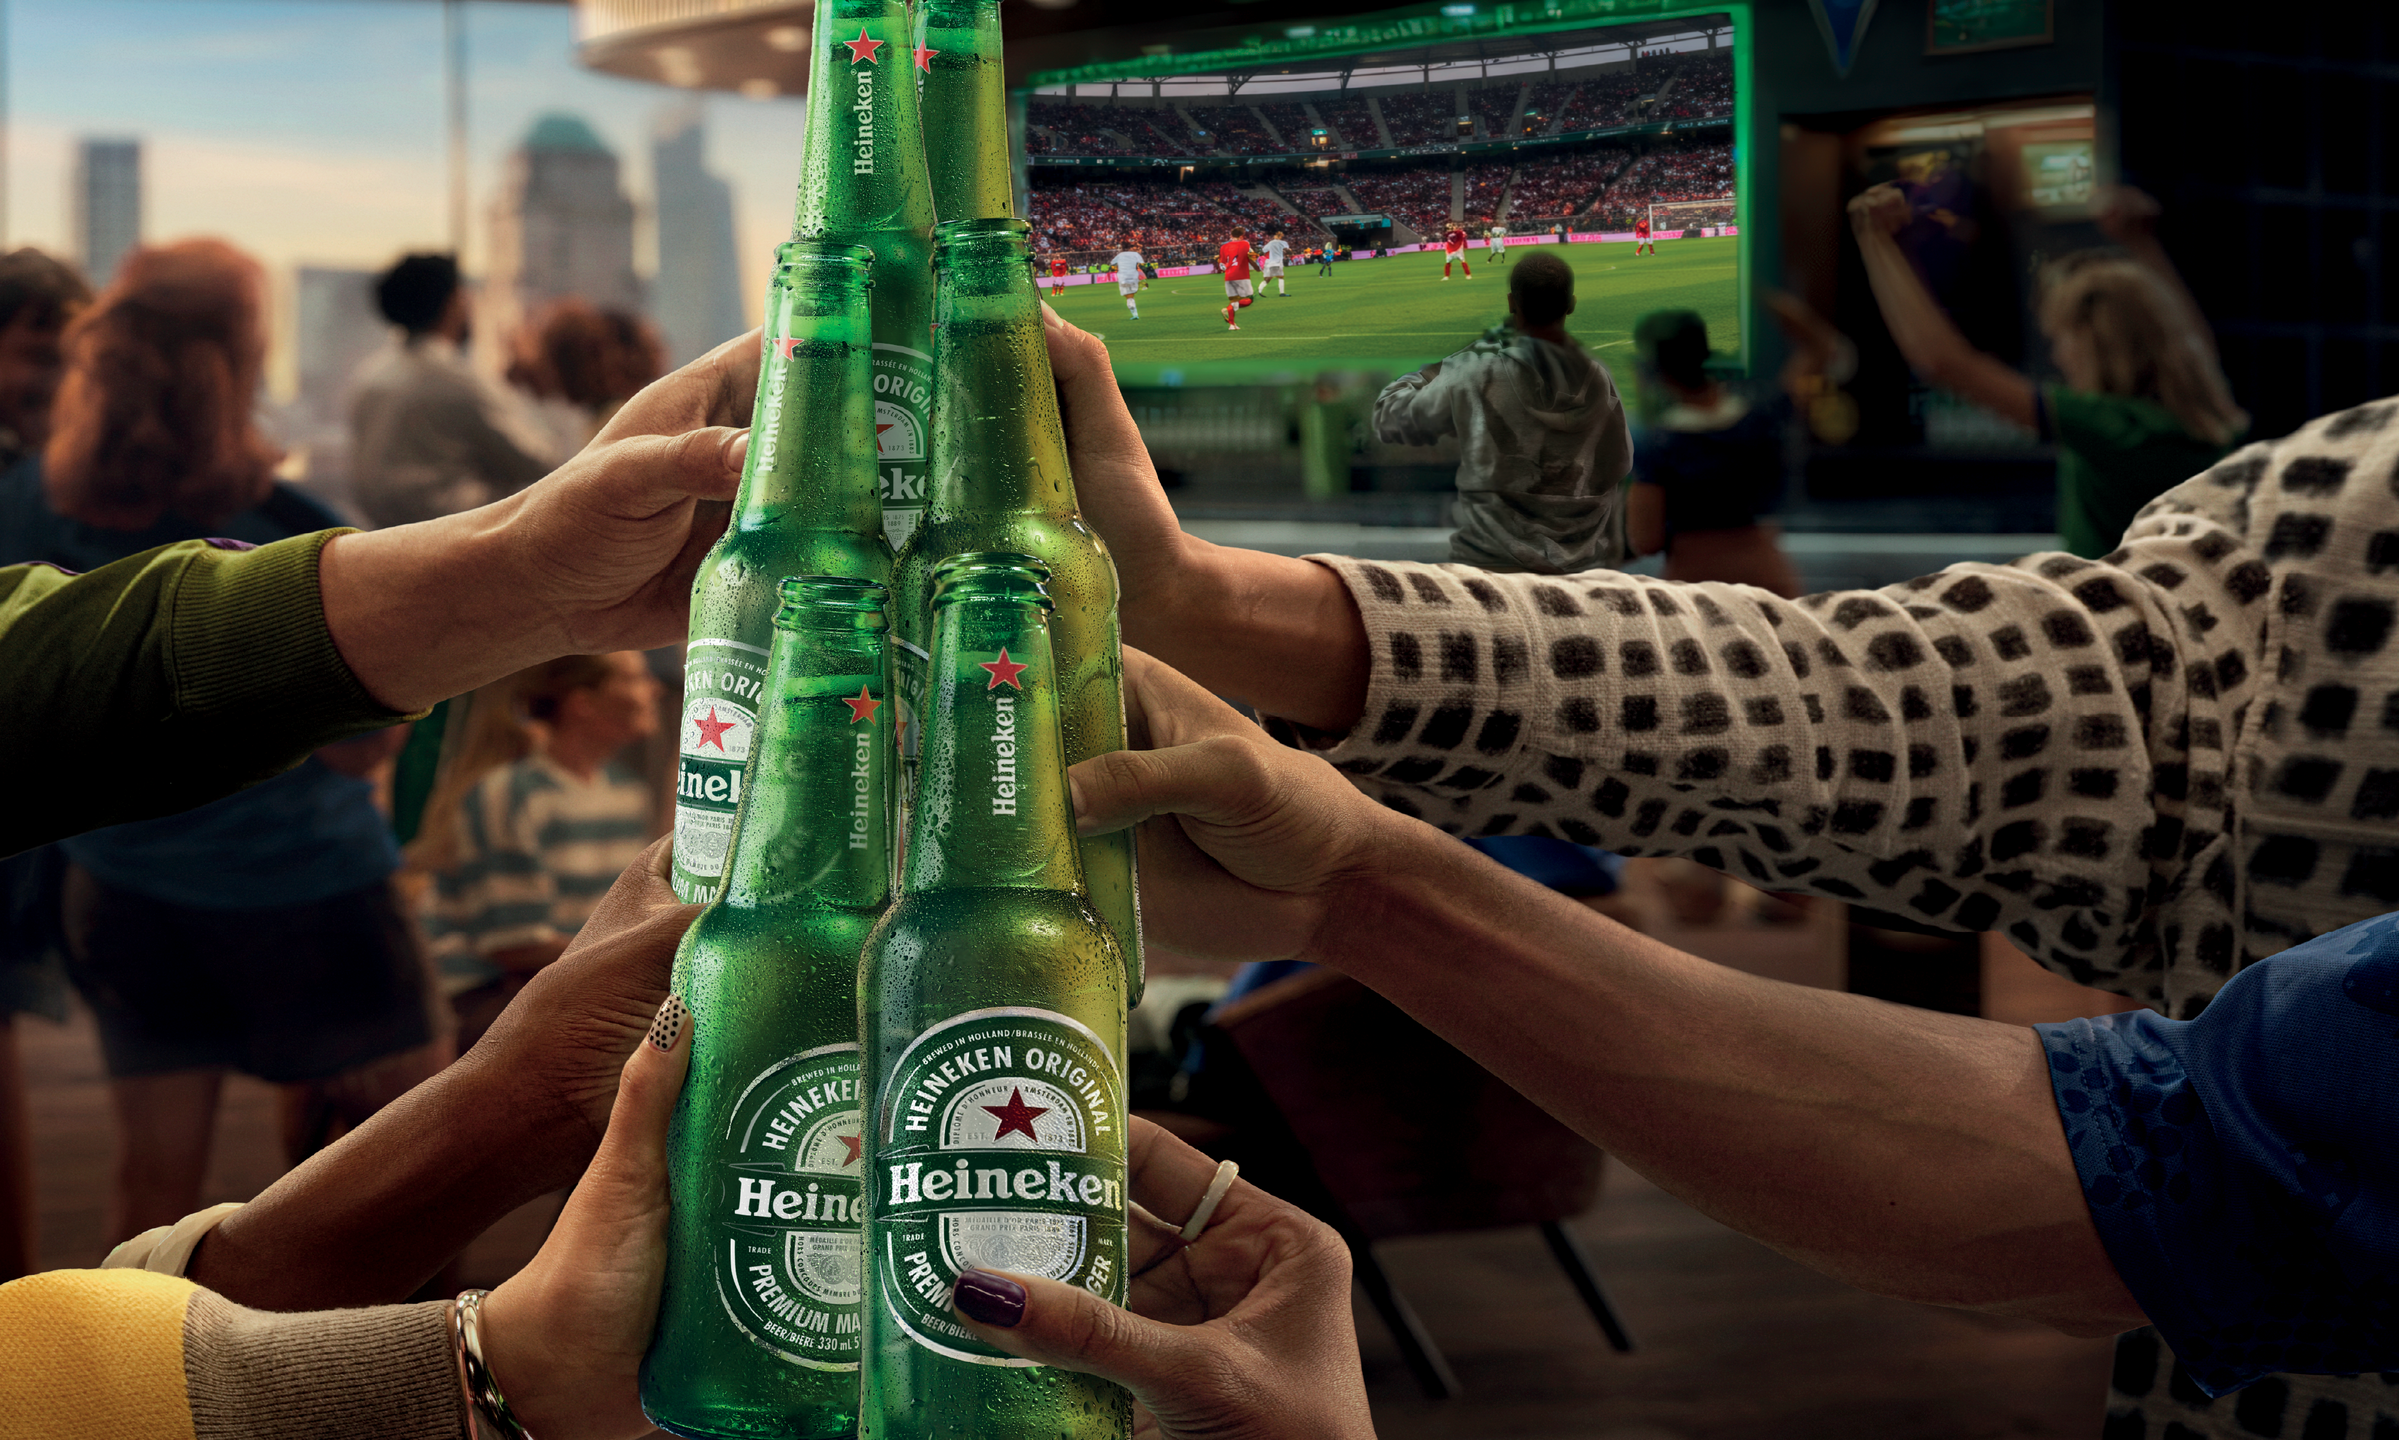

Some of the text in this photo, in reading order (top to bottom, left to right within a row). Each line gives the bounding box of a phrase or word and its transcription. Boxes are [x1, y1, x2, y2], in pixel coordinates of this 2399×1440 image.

[854, 70, 874, 175] Heineken
[898, 363, 908, 371] EN
[908, 366, 932, 384] HOLLAN
[757, 363, 789, 473] Heineken
[876, 407, 910, 428] MSTERDAM
[744, 662, 755, 671] EN
[991, 697, 1017, 817] Heineken
[849, 732, 871, 850] Heineken
[922, 1042, 954, 1065] BREWED
[955, 1037, 966, 1047] IN
[1054, 1037, 1065, 1046] EN
[1066, 1043, 1100, 1071] HOLLANDE
[791, 1069, 824, 1086] BREWED
[826, 1066, 836, 1075] IN
[905, 1046, 1111, 1136] HEINEKEN ORIGINAL
[962, 1085, 1008, 1109] D'HONNEUR
[1024, 1086, 1068, 1114] AMSTERDAM
[888, 1158, 1122, 1211] Heineken
[902, 1233, 925, 1242] TRADE
[952, 1217, 960, 1237] HORS
[999, 1224, 1016, 1232] PRIX
[748, 1245, 772, 1254] TRADE
[904, 1251, 954, 1312] PREM
[1085, 1254, 1112, 1296] GER
[749, 1264, 861, 1334] PREMIUM MA
[818, 1338, 838, 1350] 330
